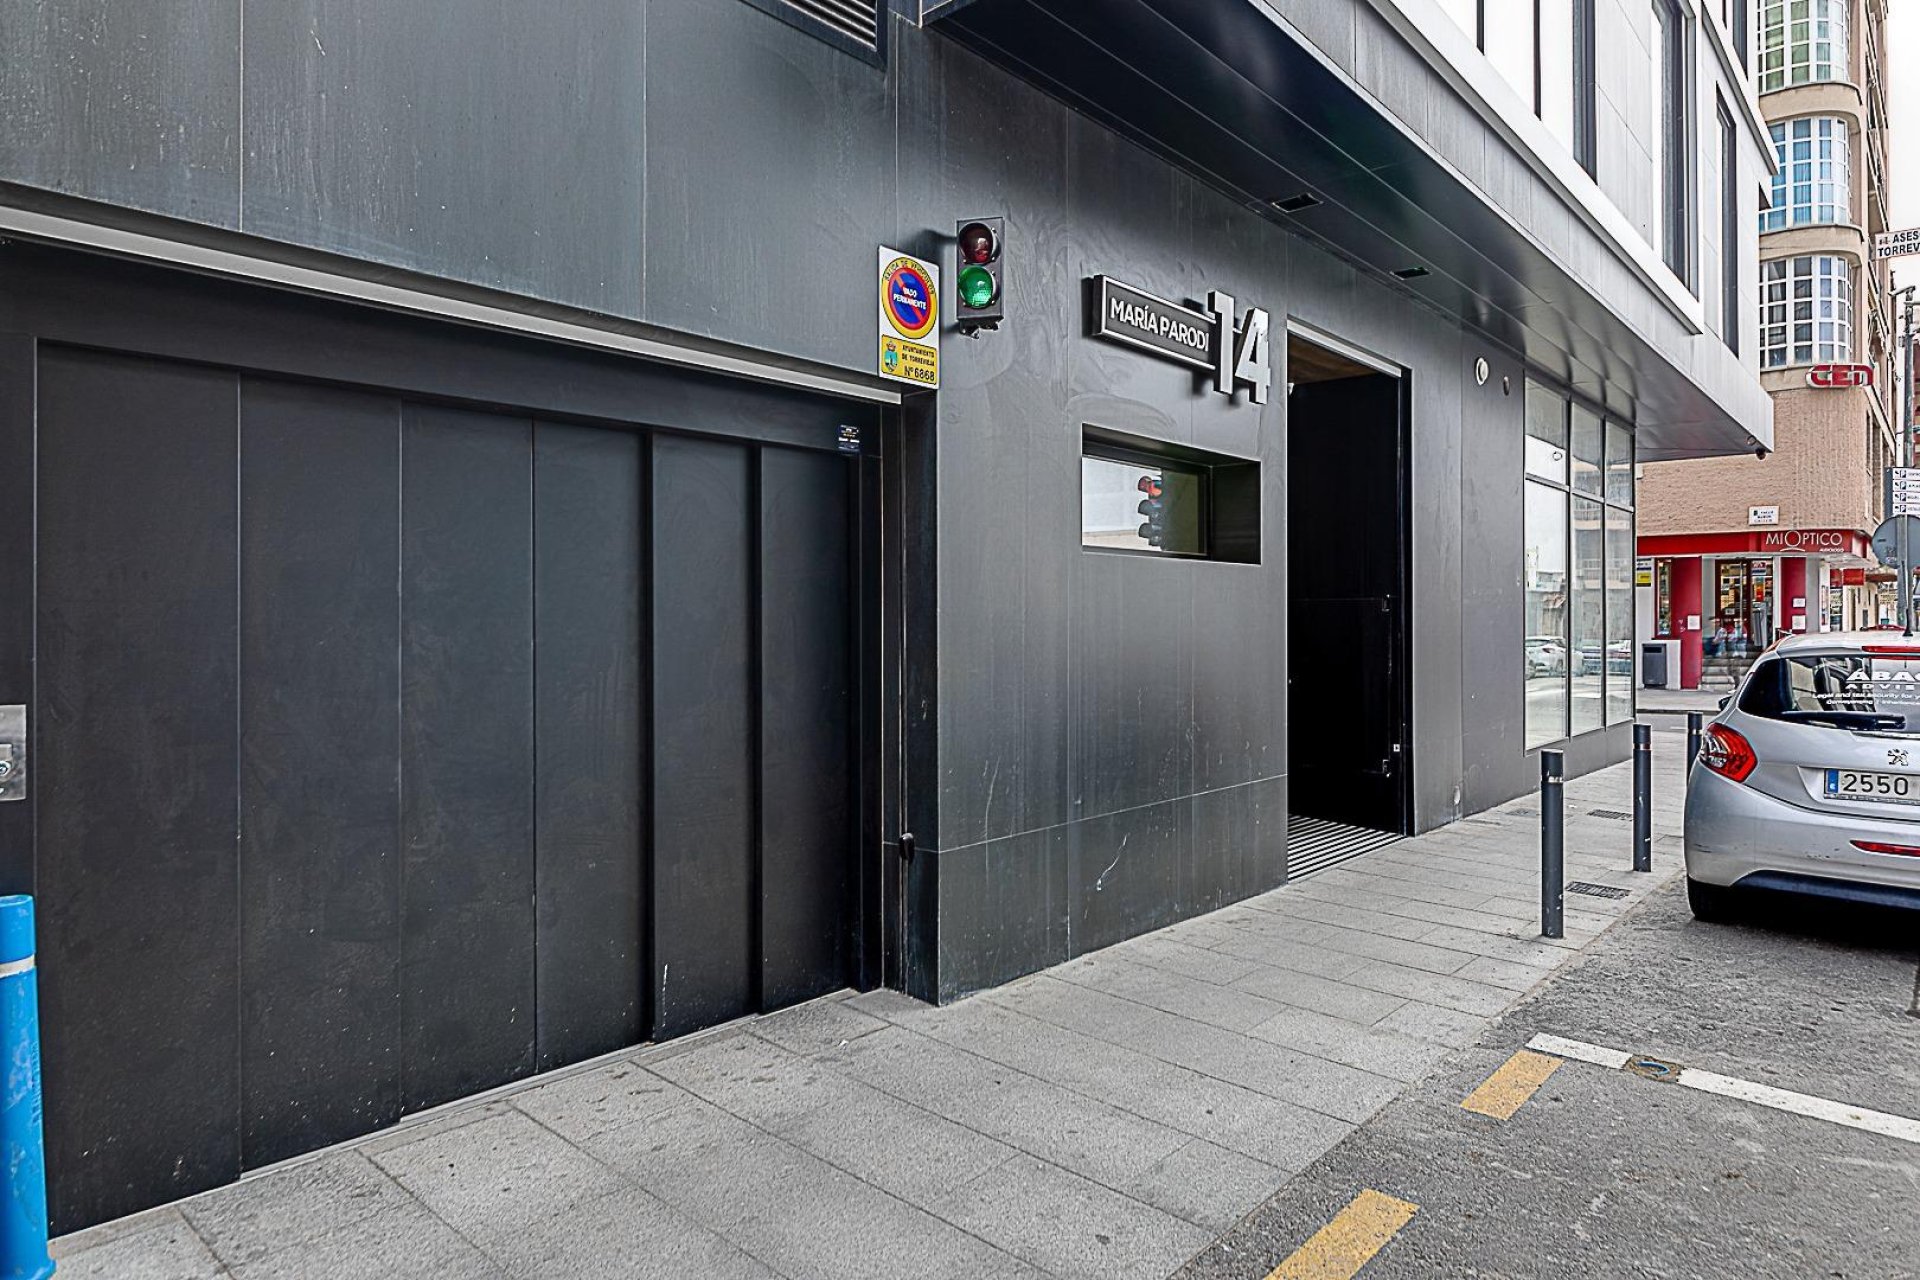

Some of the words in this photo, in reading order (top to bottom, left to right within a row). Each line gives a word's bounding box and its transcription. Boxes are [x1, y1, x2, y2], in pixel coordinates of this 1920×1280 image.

[1893, 231, 1918, 243] ASES
[903, 287, 917, 298] VADO
[893, 293, 927, 310] PERMANENTE
[1110, 297, 1158, 334] MARÍA
[1159, 317, 1209, 351] PARODI
[902, 345, 934, 358] AYUNTAMIENTO
[1208, 290, 1271, 404] 14
[902, 353, 908, 361] DE
[909, 355, 935, 367] TORREVIEJA
[1843, 774, 1909, 796] 2550
